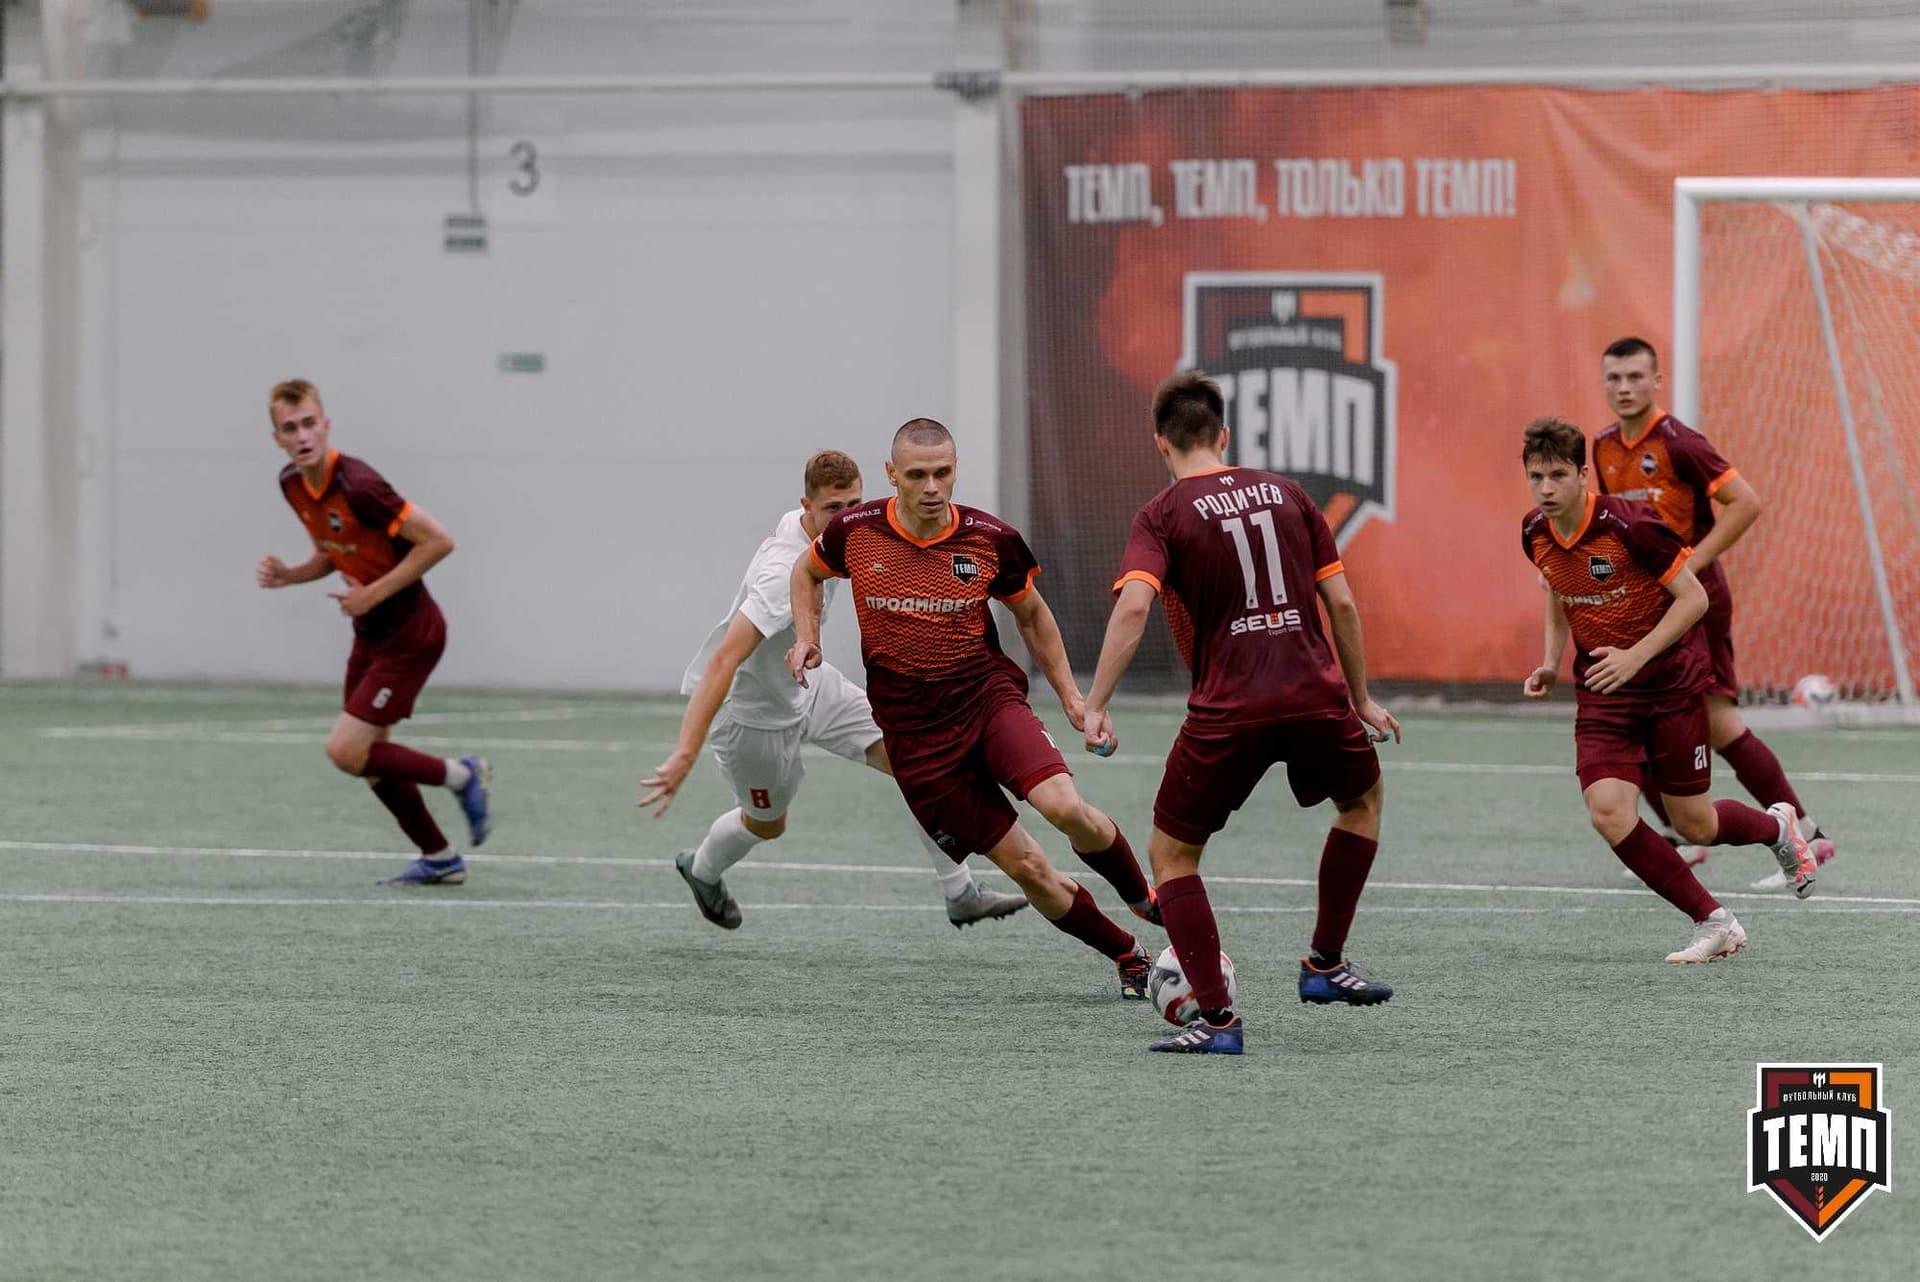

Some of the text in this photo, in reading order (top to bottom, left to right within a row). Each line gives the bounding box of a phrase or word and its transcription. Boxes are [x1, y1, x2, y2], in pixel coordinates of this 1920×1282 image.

[508, 140, 541, 197] 3
[1065, 159, 1516, 227] ТЕМП, ТЕМП, ТОЛЬКО ТЕМП!
[1193, 482, 1283, 521] РОДИЧЕВ
[954, 563, 977, 575] ТЕМП
[1220, 509, 1289, 609] 11
[1230, 609, 1301, 636] SEUS
[372, 687, 393, 709] 6
[1694, 744, 1708, 770] 21
